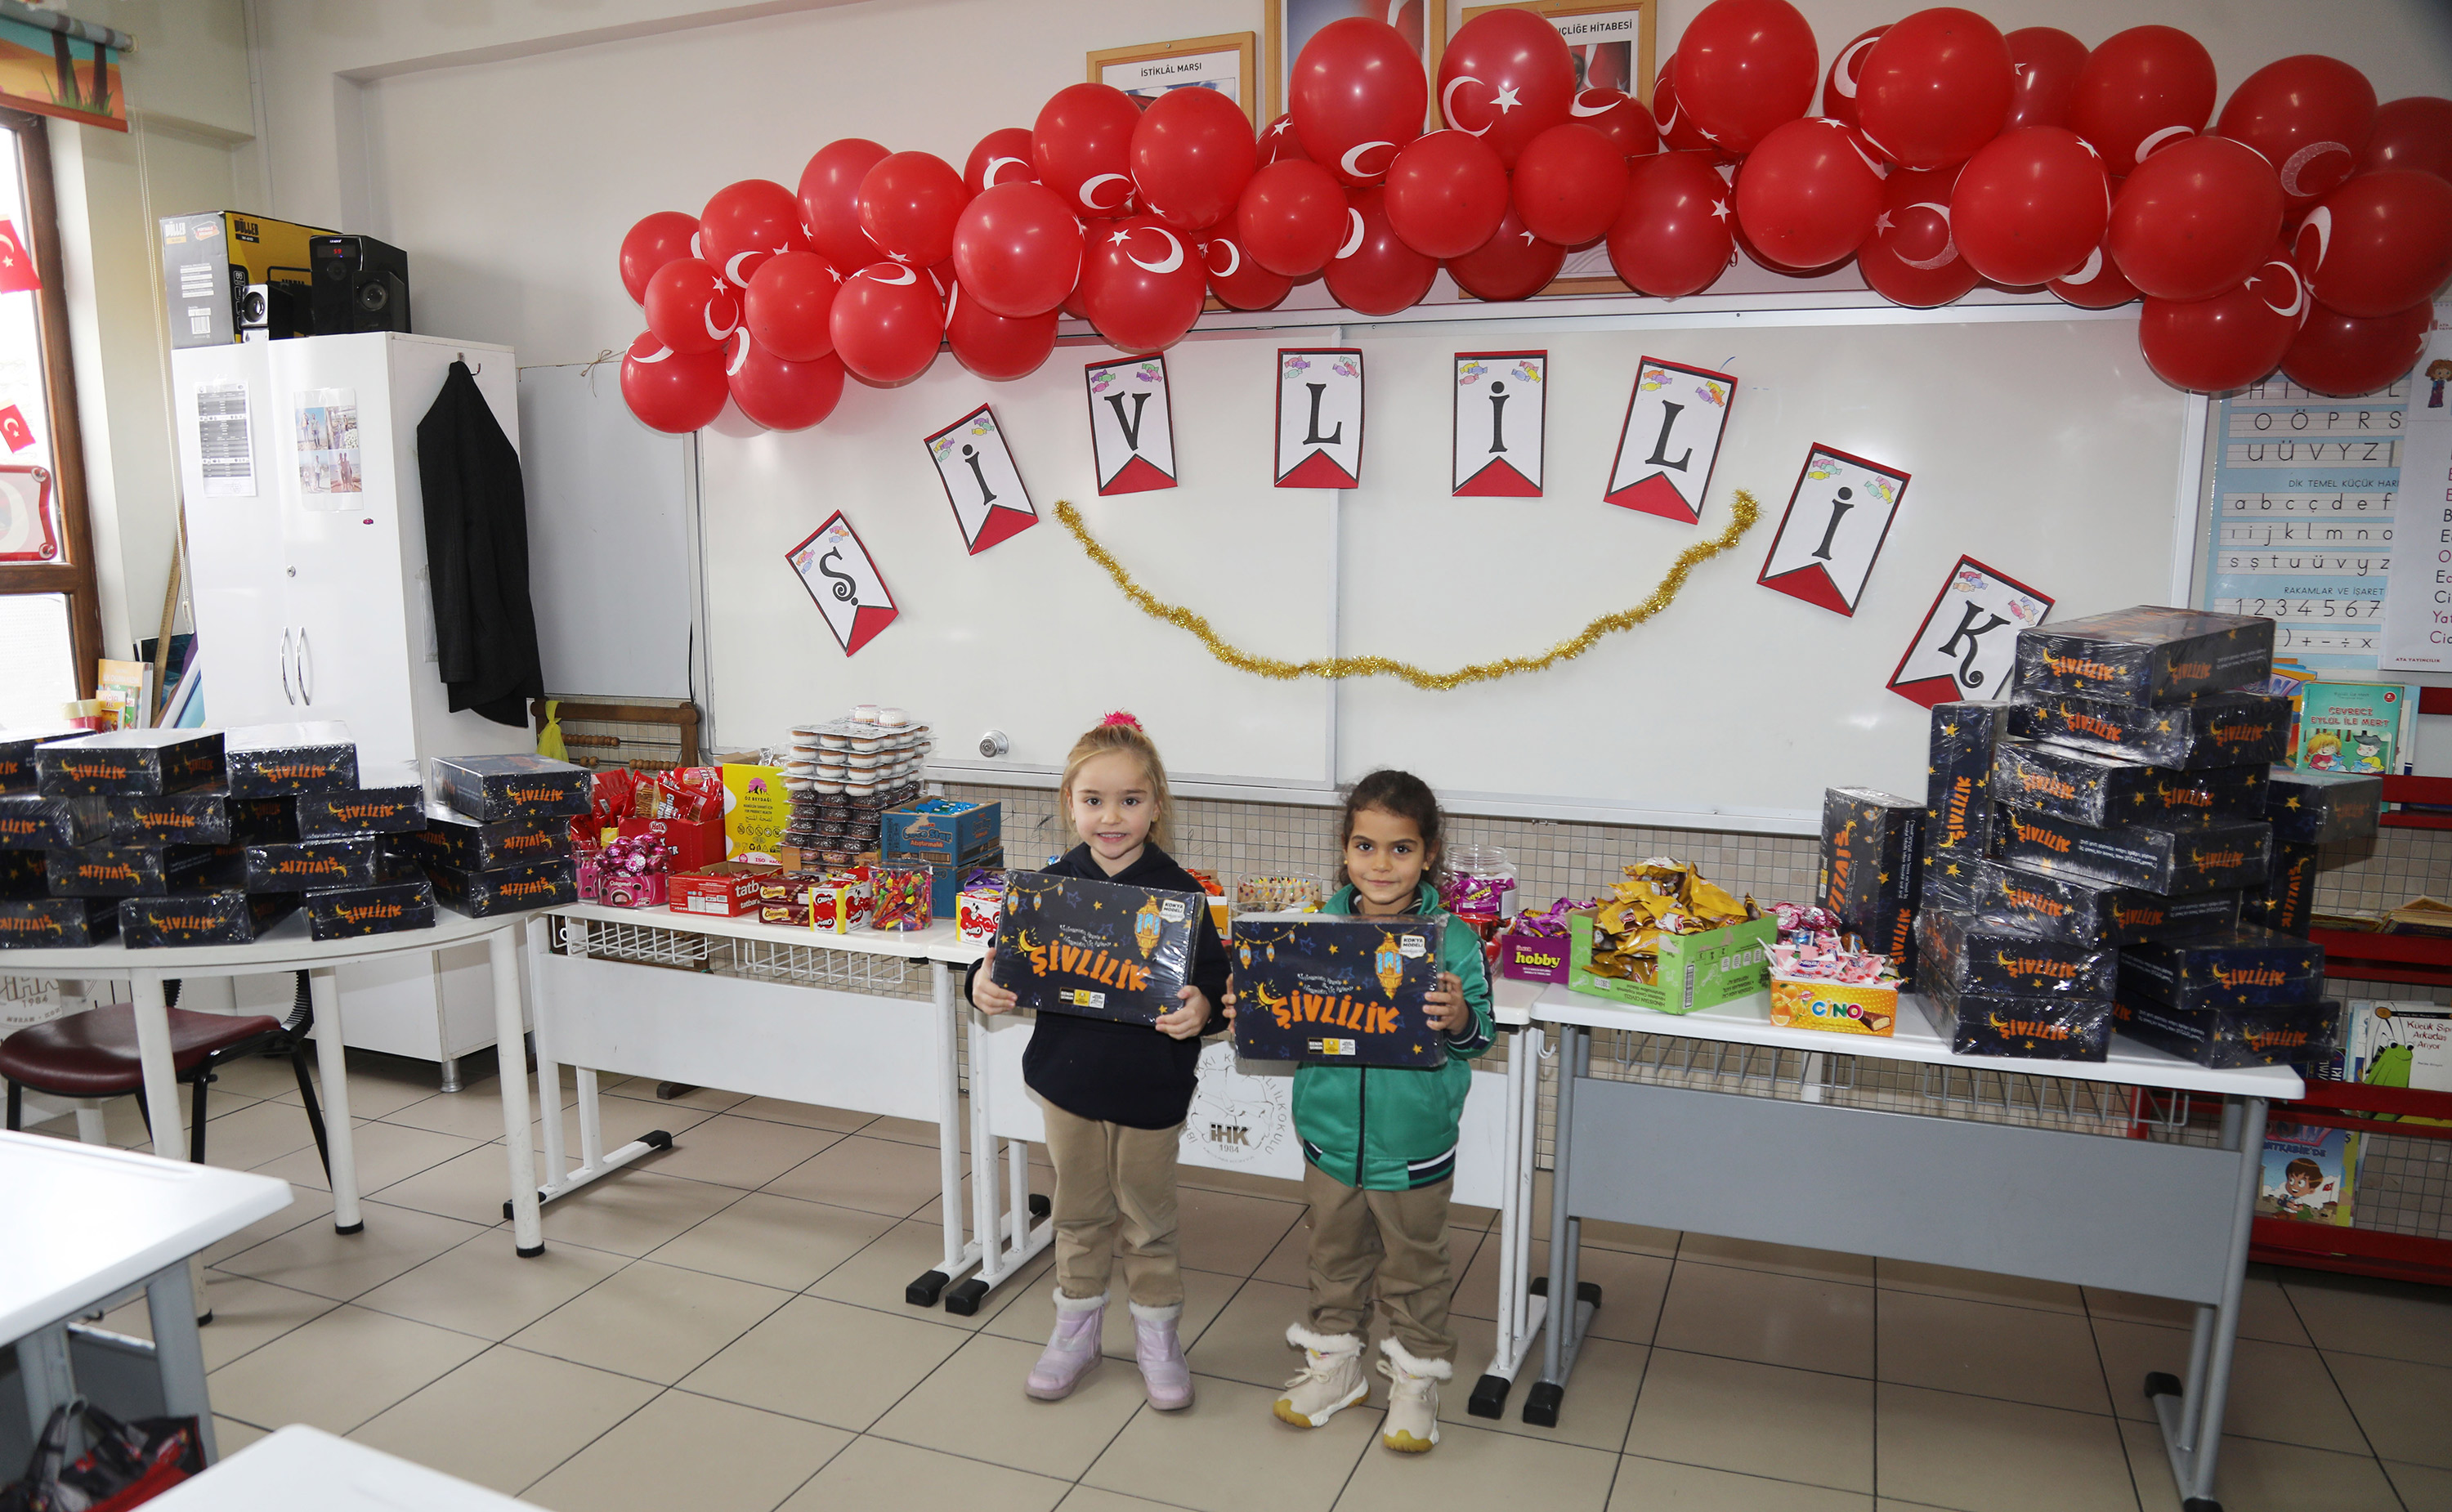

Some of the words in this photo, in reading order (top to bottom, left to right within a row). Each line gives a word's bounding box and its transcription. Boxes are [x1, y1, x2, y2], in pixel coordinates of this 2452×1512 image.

[1559, 23, 1587, 35] ÇLİĞE
[1591, 19, 1632, 32] HİTABESİ
[1141, 65, 1175, 77] İSTİKLÂL
[1178, 62, 1201, 73] MARŞI
[2255, 413, 2272, 431] O
[2291, 409, 2308, 431] Ö
[2329, 412, 2339, 429] P
[2359, 412, 2369, 429] R
[2388, 411, 2401, 429] S
[2248, 444, 2264, 461] U
[2279, 441, 2294, 461] Ü
[2309, 444, 2324, 461] V
[2338, 443, 2352, 460] Y
[2363, 442, 2378, 461] Z
[2289, 479, 2303, 488] DİK
[2308, 479, 2338, 488] TEMEL
[2342, 478, 2374, 490] KÜÇÜK
[1104, 391, 1152, 451] V
[1303, 383, 1342, 445] L
[1644, 400, 1693, 472] L
[1937, 599, 2011, 688] K
[2284, 587, 2333, 596] RAKAMLAR
[2338, 587, 2349, 596] VE
[2353, 586, 2384, 597] İŞARET
[2236, 598, 2243, 616] 1
[2254, 598, 2265, 616] 2
[2275, 599, 2287, 616] 3
[2298, 599, 2312, 616] 4
[2324, 599, 2335, 616] 5
[2345, 600, 2357, 617] 6
[2369, 600, 2380, 618] 7
[2311, 716, 2341, 725] EYLÜL
[2361, 718, 2390, 727] MERT
[267, 763, 327, 783] ŞİVLİLİK
[513, 788, 564, 805] ŞİVLİLİK
[338, 804, 396, 823] ŞİVLİLİK
[0, 819, 36, 834] LİLİK
[928, 830, 952, 843] Star
[2017, 824, 2072, 853] ŞİVLİLİK
[736, 879, 760, 897] tatb
[345, 904, 402, 924] ŞİVLİLİK
[1030, 940, 1151, 991] ŞİVLİLİK
[1515, 951, 1561, 968] hobby
[22, 995, 49, 1009] 1984
[1272, 990, 1400, 1034] ŞİVLİLİK
[1219, 1144, 1240, 1153] 1984
